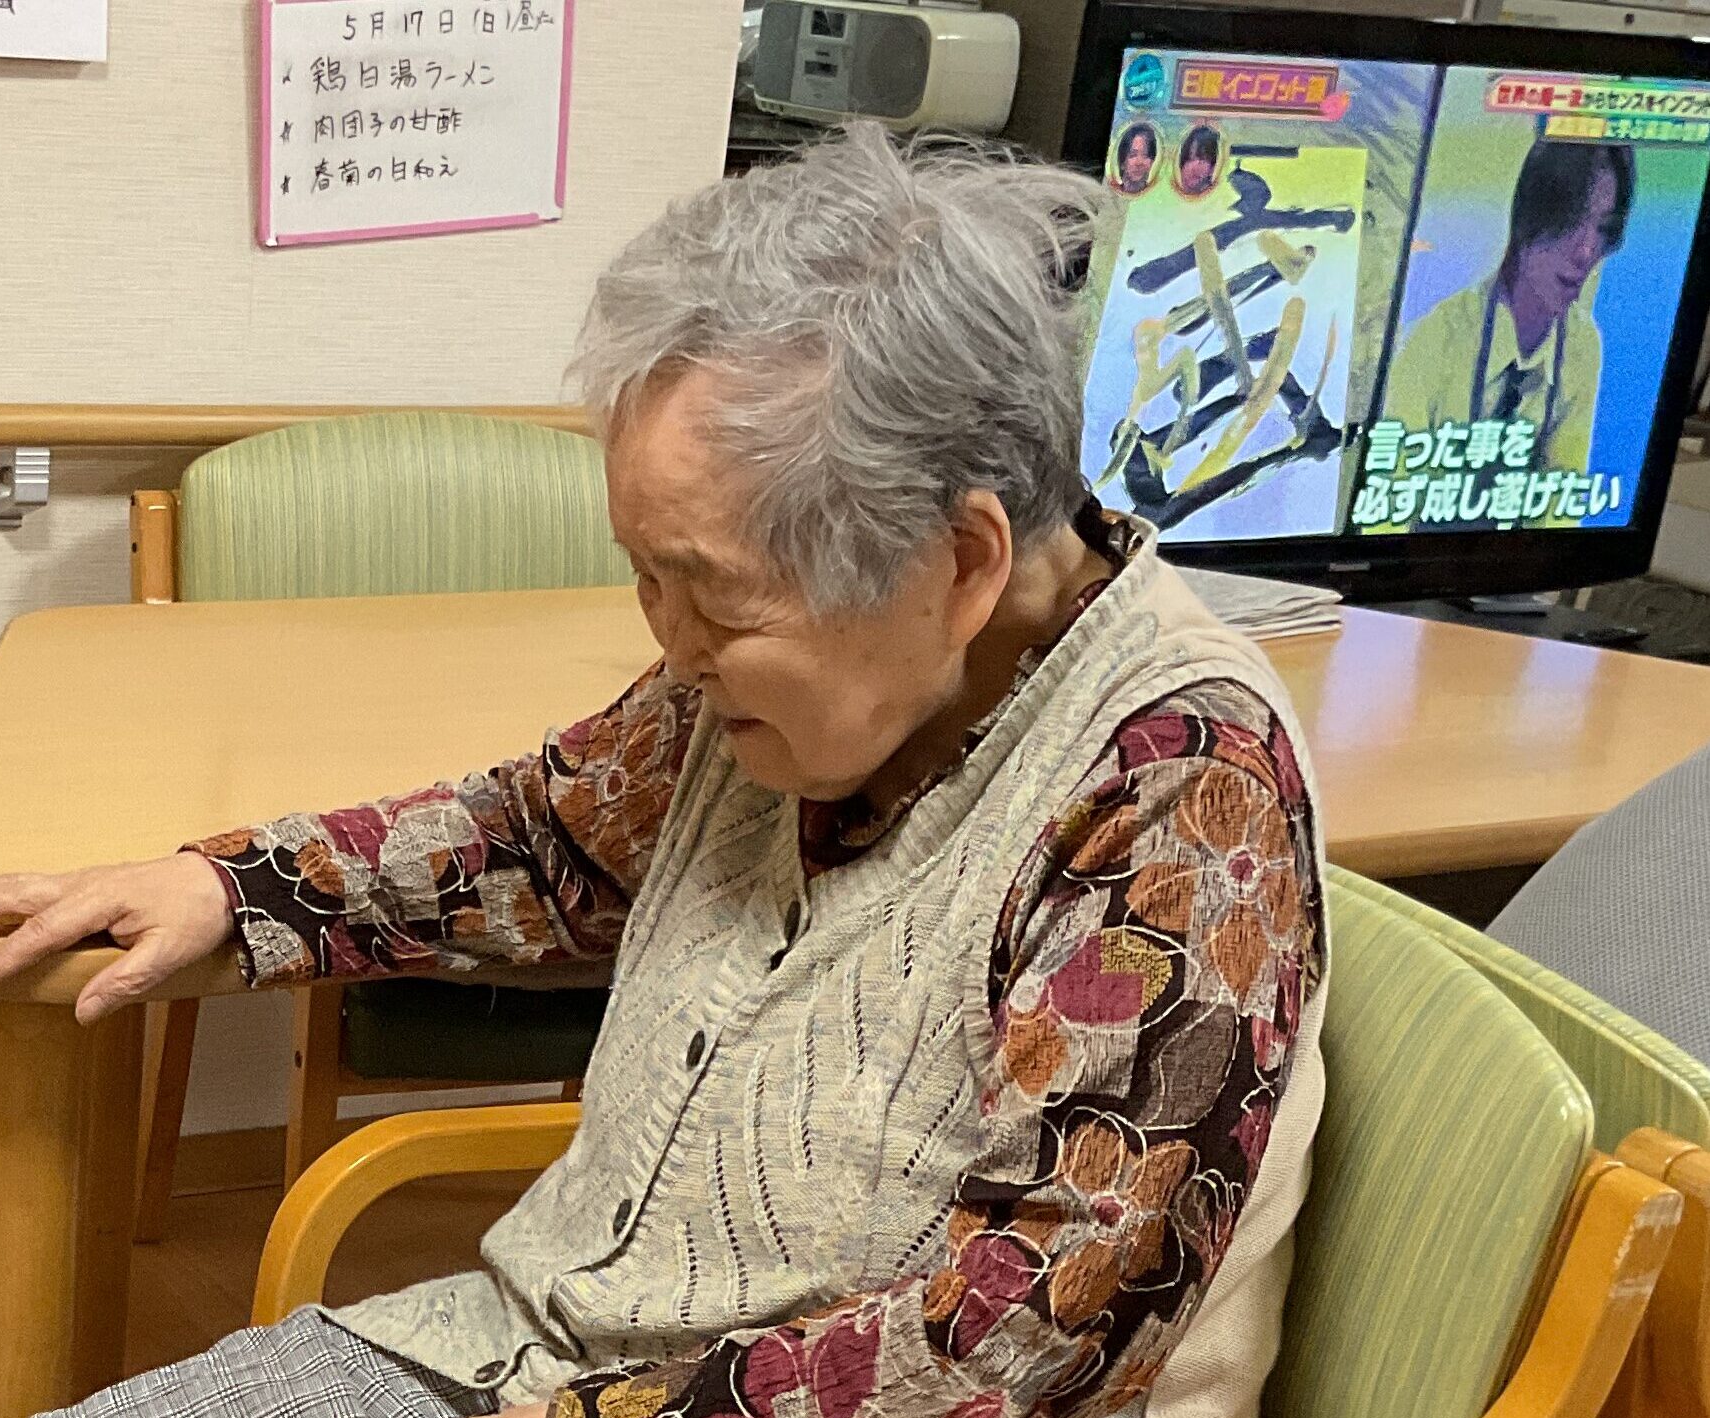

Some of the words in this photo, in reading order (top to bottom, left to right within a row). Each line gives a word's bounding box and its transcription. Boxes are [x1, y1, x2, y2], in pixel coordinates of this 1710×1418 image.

[309, 55, 495, 95] 鶏白湯ラーメン
[313, 106, 463, 144] 肉団子の甘酢
[1364, 419, 1536, 471] 言った事を
[1352, 472, 1621, 526] 必ず成し遂げたい
